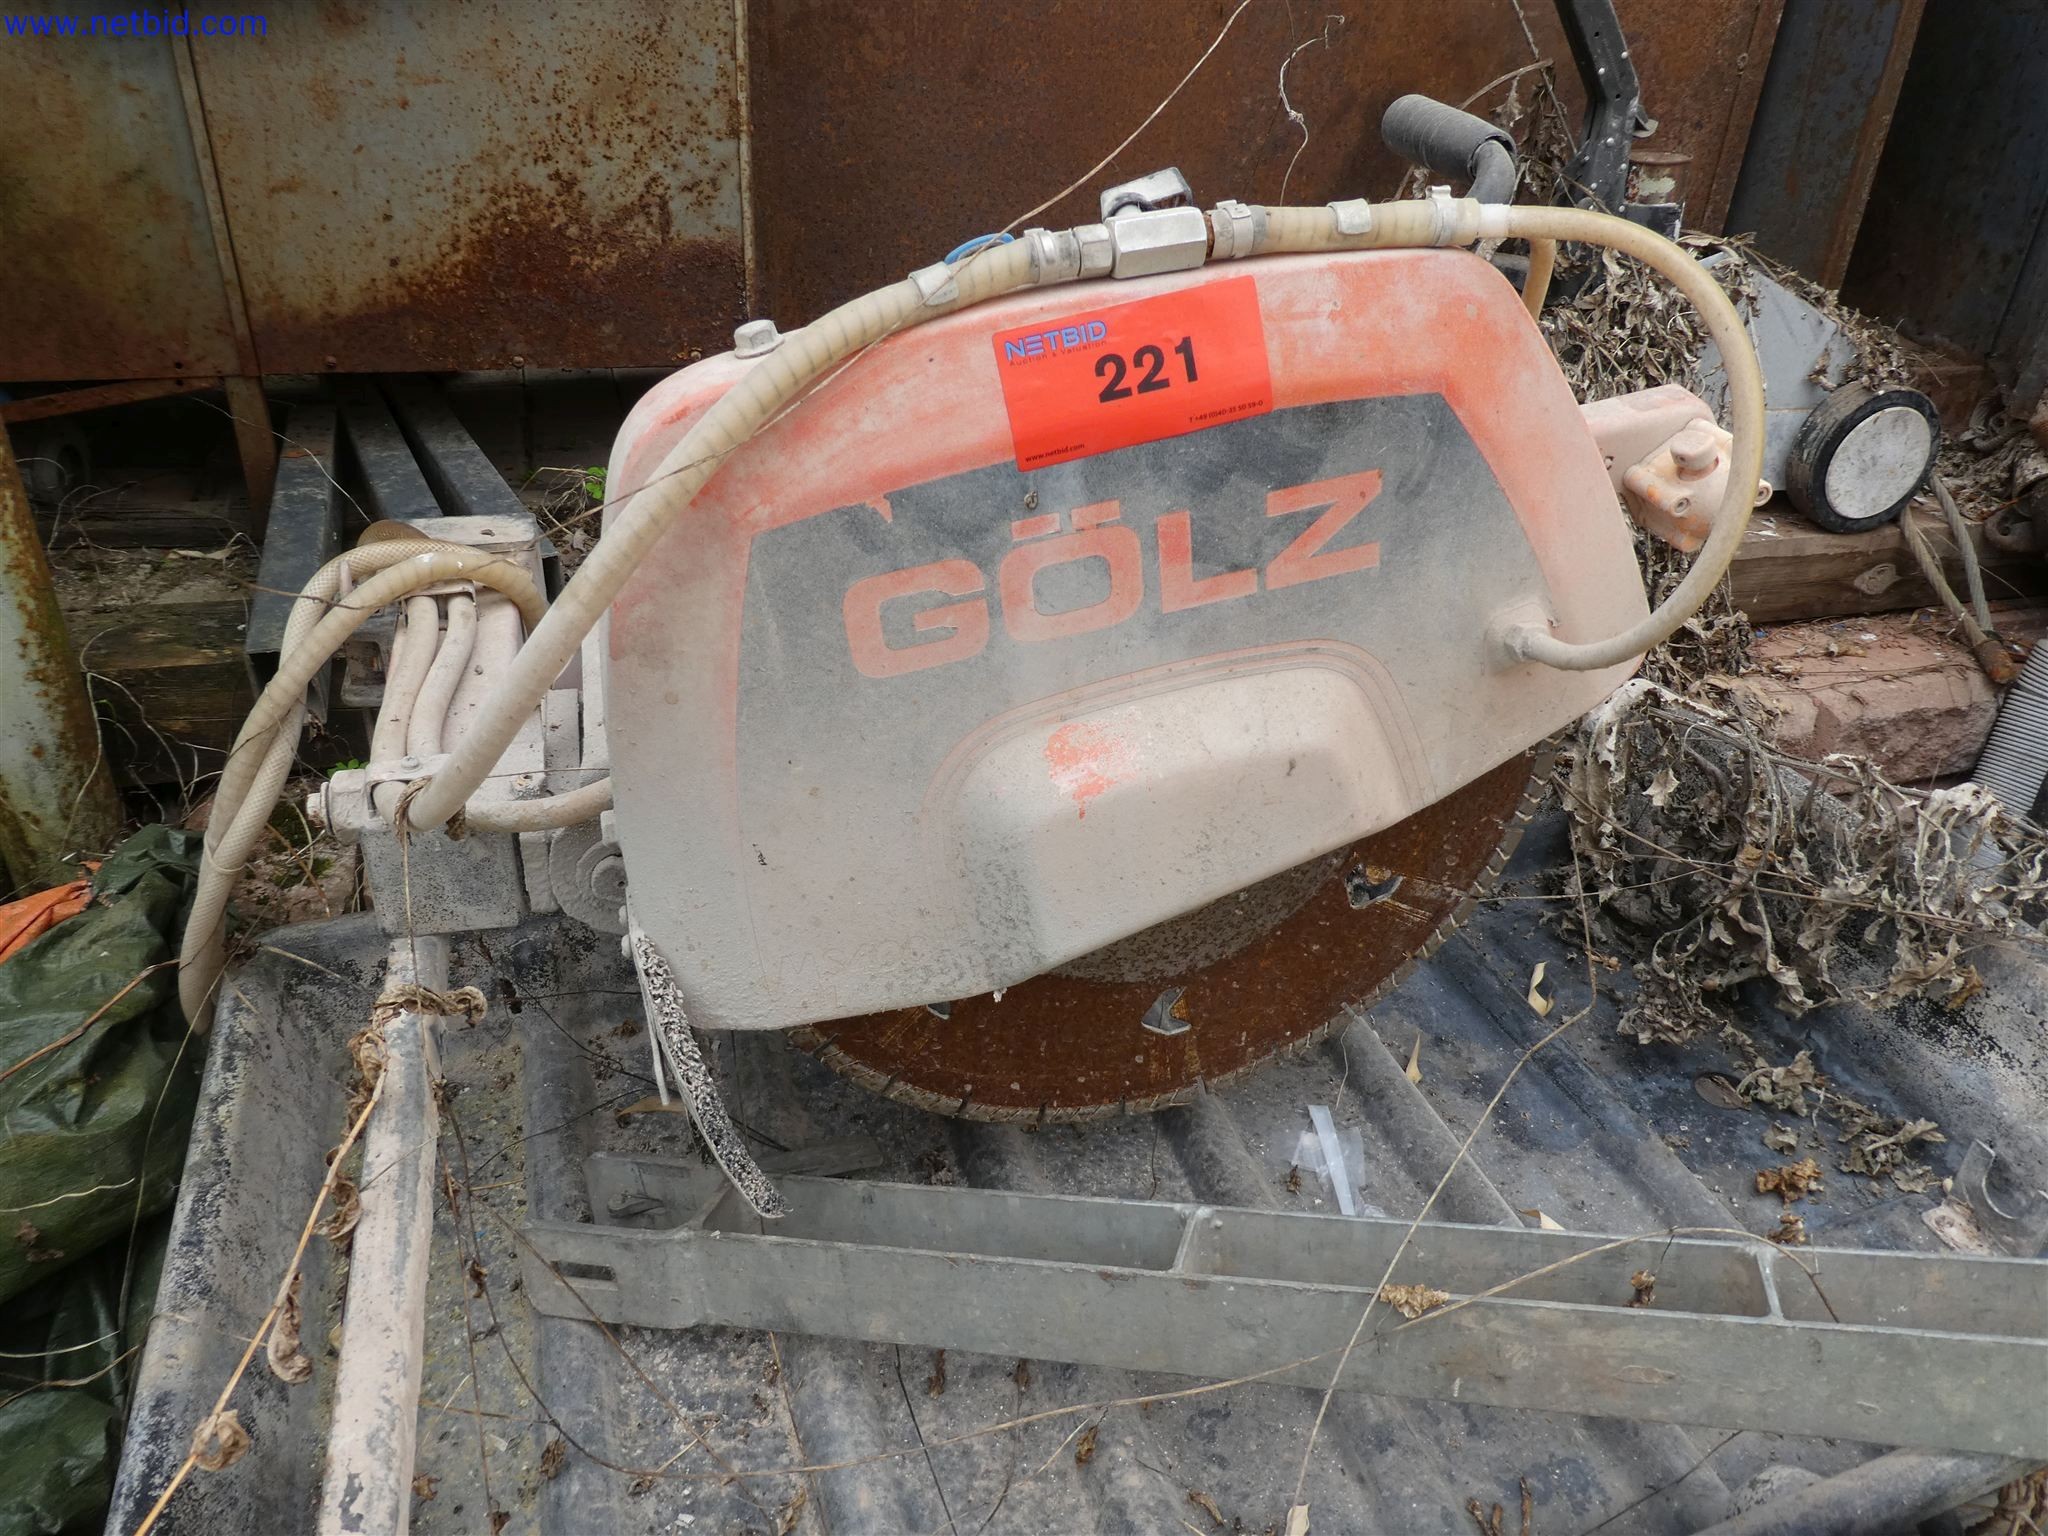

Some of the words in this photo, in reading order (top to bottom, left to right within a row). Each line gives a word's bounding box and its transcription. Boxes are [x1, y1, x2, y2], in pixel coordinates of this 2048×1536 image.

[1004, 320, 1107, 361] NETBID
[1009, 354, 1048, 366] Auction
[1094, 336, 1198, 403] 221
[1025, 444, 1085, 462] www.netbid.com
[842, 469, 1382, 679] GÖLZ
